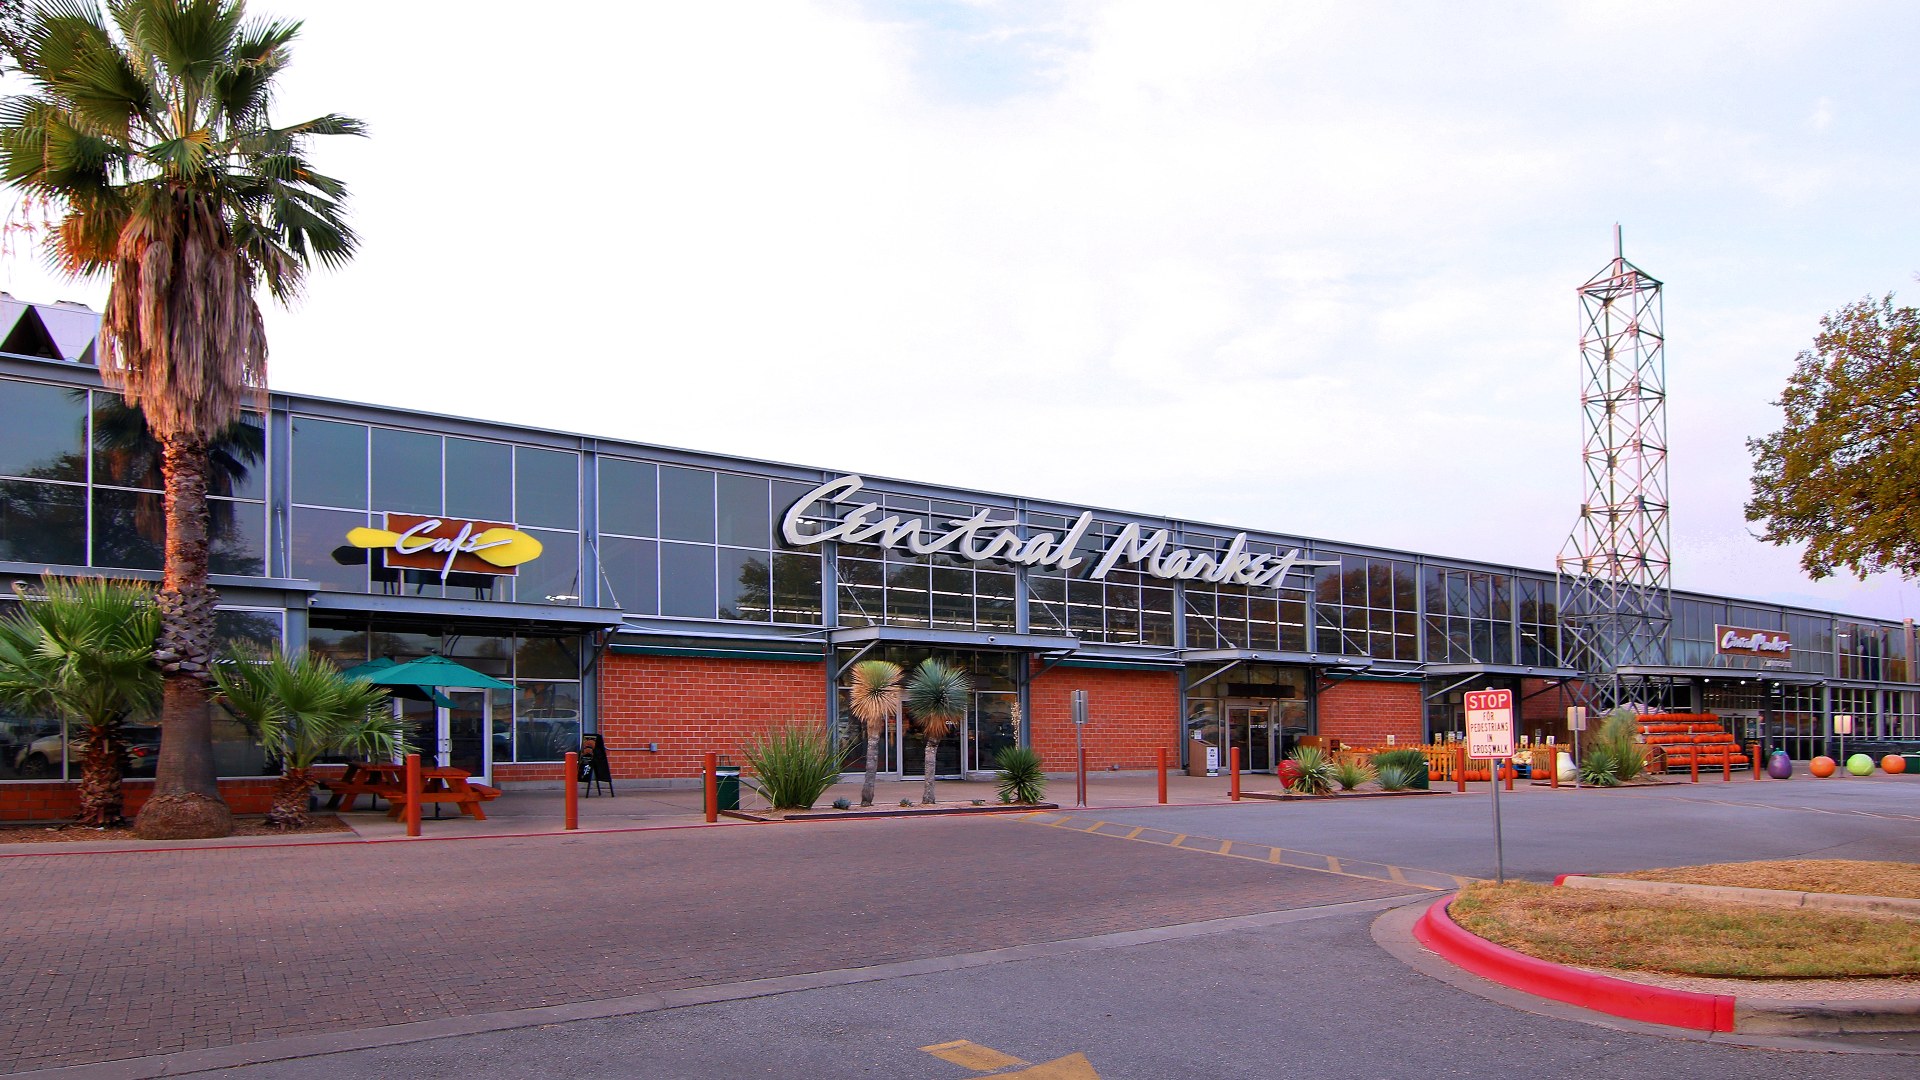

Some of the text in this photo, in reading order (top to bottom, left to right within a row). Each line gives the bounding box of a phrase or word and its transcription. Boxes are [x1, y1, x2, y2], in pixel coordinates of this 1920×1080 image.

[783, 475, 1342, 588] Central Market
[396, 519, 513, 580] Cafe
[1469, 693, 1507, 709] STOP
[1482, 711, 1495, 721] FOR
[1470, 722, 1509, 732] PEDESTRIANS
[1487, 734, 1493, 743] IN
[1472, 744, 1508, 754] CROSSWALK
